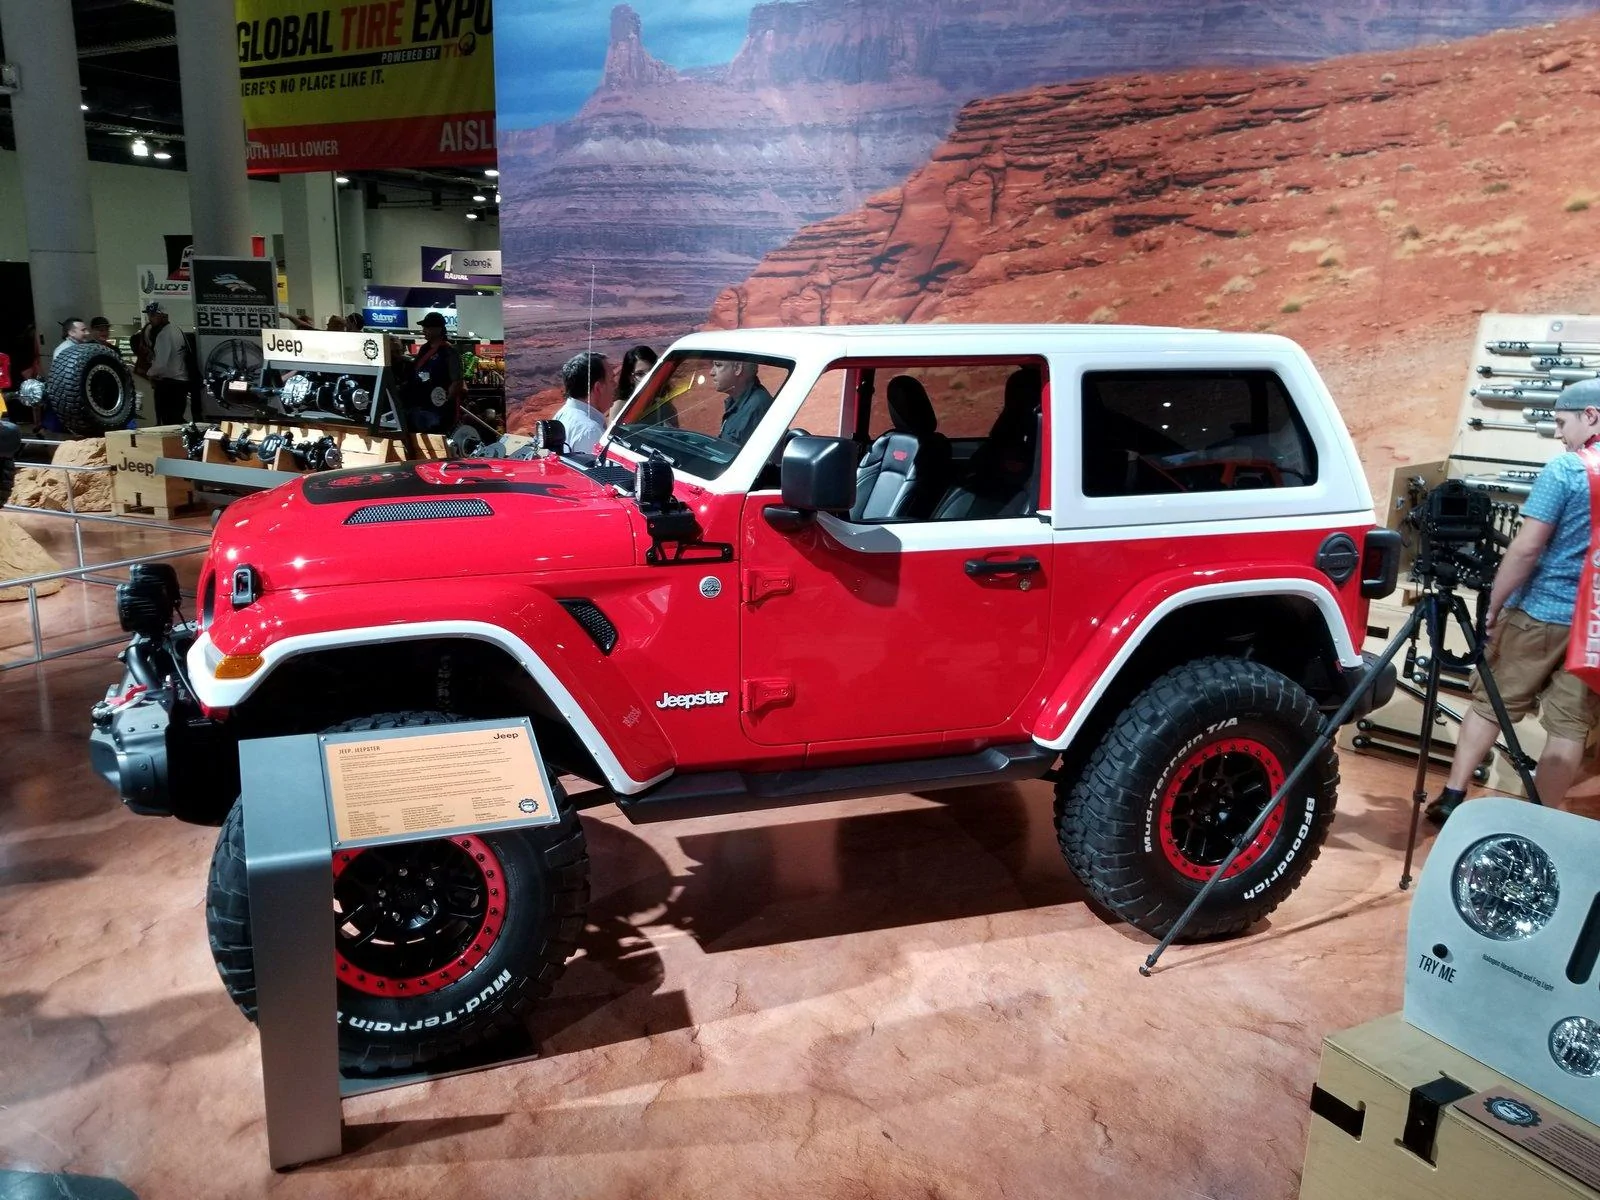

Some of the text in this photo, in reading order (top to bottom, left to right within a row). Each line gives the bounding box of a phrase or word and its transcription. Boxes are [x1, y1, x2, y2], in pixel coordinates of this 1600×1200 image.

[237, 0, 494, 62] GLOBAL TIRE EXPO
[381, 49, 423, 64] POWERED
[424, 48, 438, 60] BY
[280, 77, 296, 94] NO
[300, 74, 336, 92] PLACE
[340, 70, 366, 89] LIKE
[371, 69, 385, 85] IT.
[272, 142, 298, 159] HALL
[301, 140, 340, 158] LOWER
[463, 258, 487, 268] Sutong
[154, 283, 189, 291] LUCY'S
[197, 312, 276, 329] BETTER!
[267, 333, 303, 356] Jeep
[1539, 357, 1562, 366] FOX
[117, 457, 155, 476] Jeep
[656, 690, 729, 709] Jeepster
[492, 731, 520, 740] Jeep
[1144, 717, 1239, 853] Mud-Terrain T/A
[1243, 797, 1316, 900] BFGoodrich
[1419, 954, 1457, 983] TRY ME
[1532, 976, 1543, 987] Fog
[349, 968, 512, 1033] Mud-Terrain
